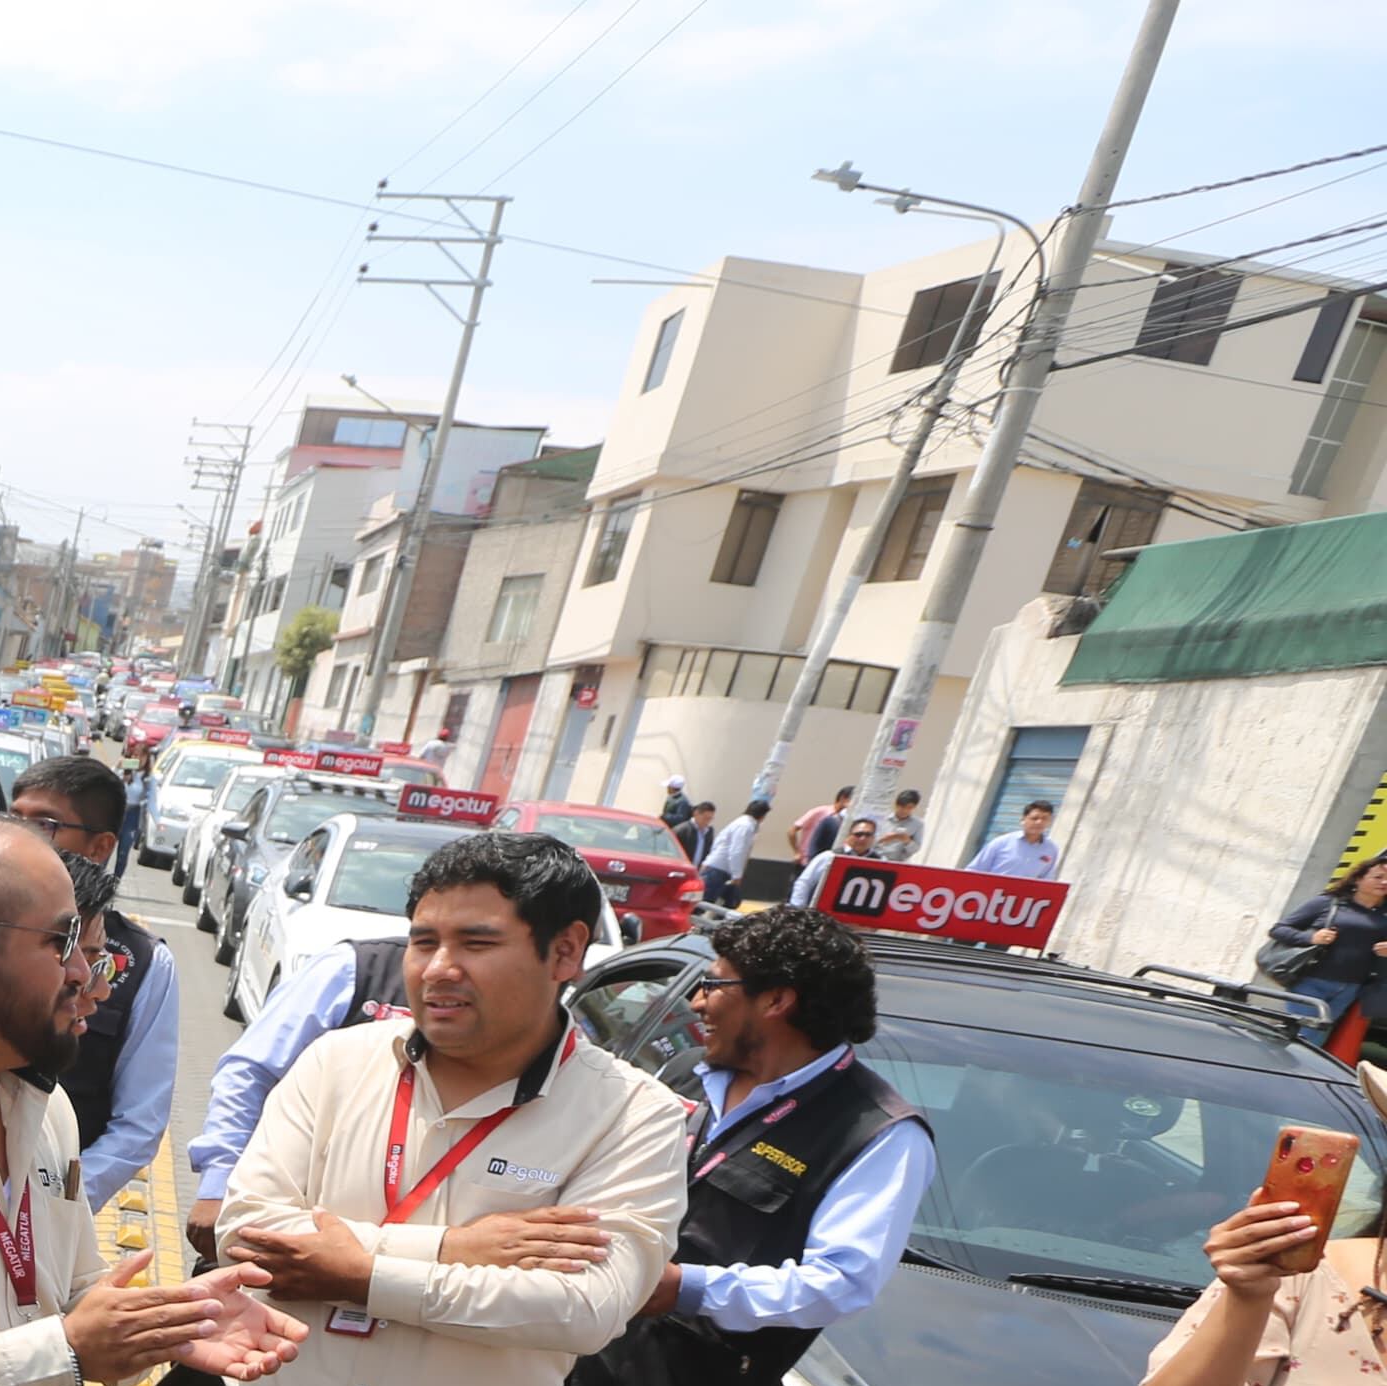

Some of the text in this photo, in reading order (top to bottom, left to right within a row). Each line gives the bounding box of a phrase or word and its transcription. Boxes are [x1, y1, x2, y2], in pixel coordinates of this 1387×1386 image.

[267, 752, 313, 767] megatur
[320, 754, 380, 773] megatur
[407, 790, 493, 816] megatur
[838, 876, 1051, 930] megatur
[386, 1144, 403, 1185] megatur
[488, 1158, 559, 1185] megatur
[750, 1141, 807, 1177] SUPERVISOR
[19, 1210, 31, 1262] MEGATUR
[0, 1231, 25, 1279] MEGATUR
